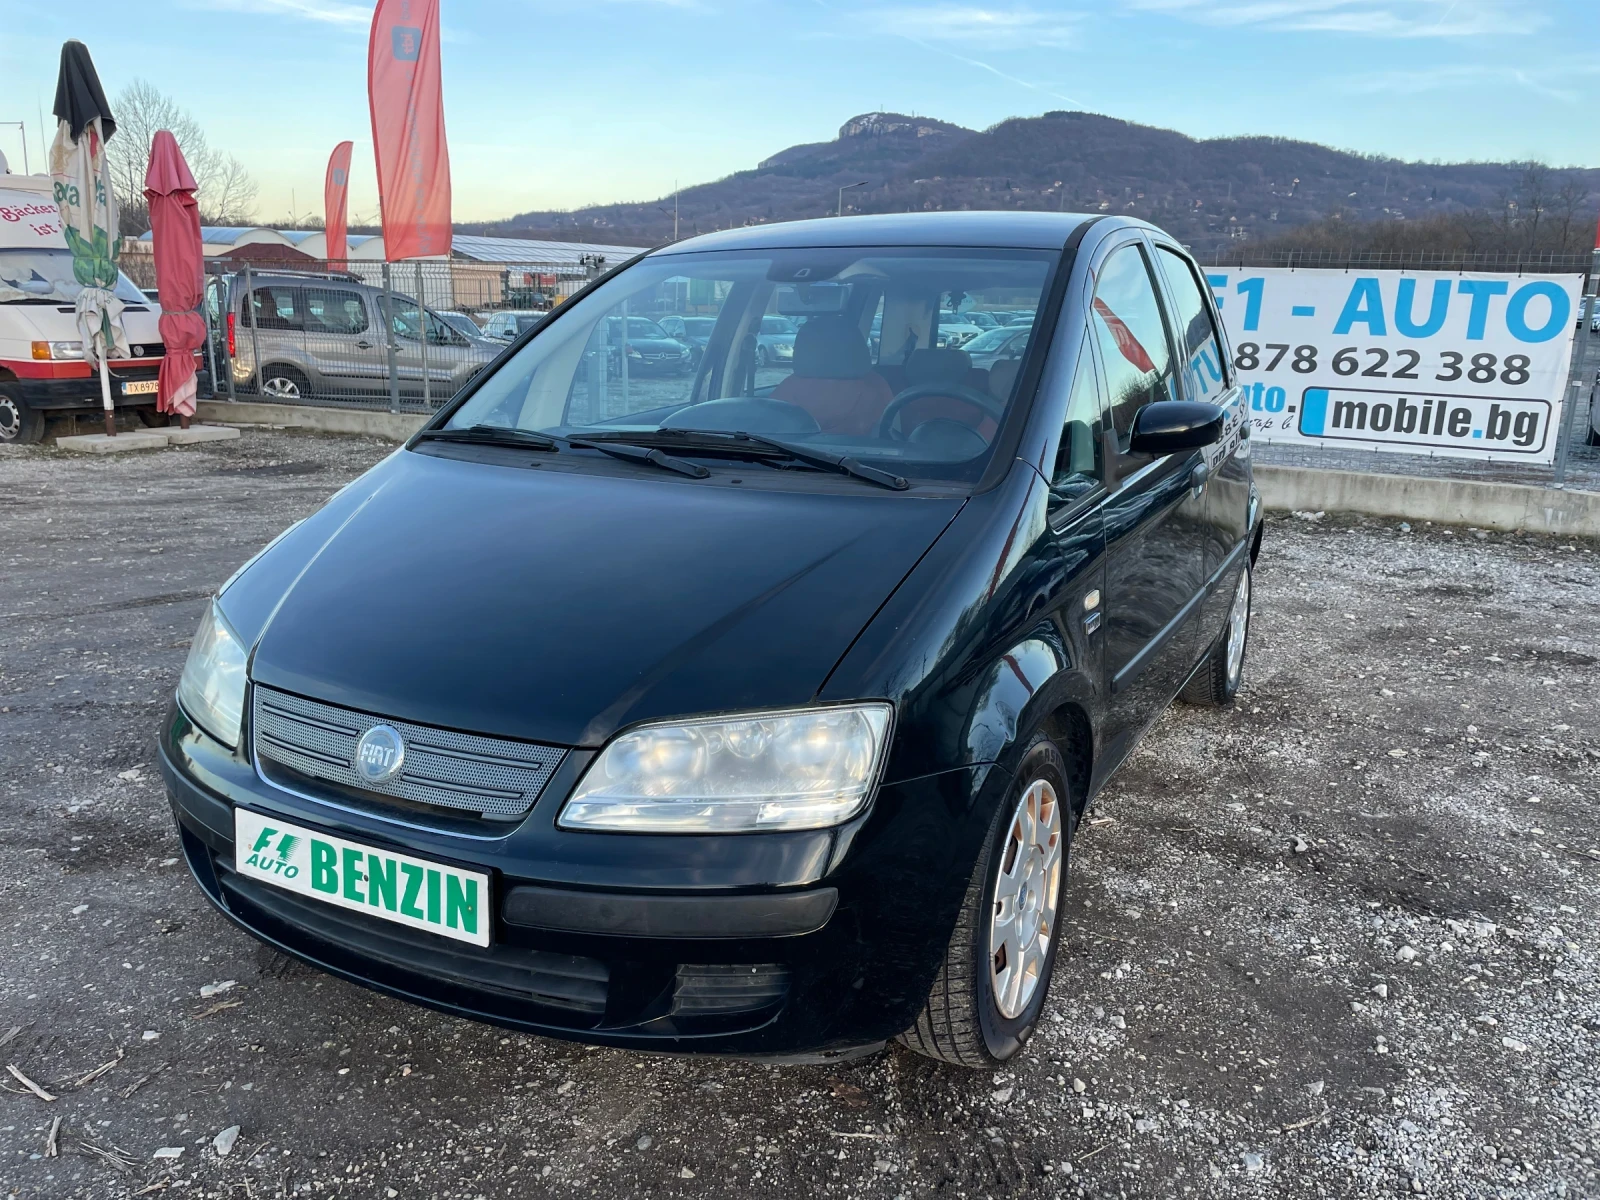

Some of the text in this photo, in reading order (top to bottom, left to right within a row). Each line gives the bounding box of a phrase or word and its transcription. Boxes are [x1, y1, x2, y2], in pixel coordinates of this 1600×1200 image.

[400, 0, 415, 55] tbi ba
[29, 222, 58, 236] ist
[1332, 277, 1571, 343] AUTO
[1331, 346, 1421, 379] 622
[1435, 351, 1531, 385] 388
[127, 383, 140, 392] TX
[1331, 397, 1539, 447] mobile.bg
[360, 743, 395, 767] FIAT
[245, 853, 299, 879] AUTO
[252, 827, 478, 934] F1 BENZIN
